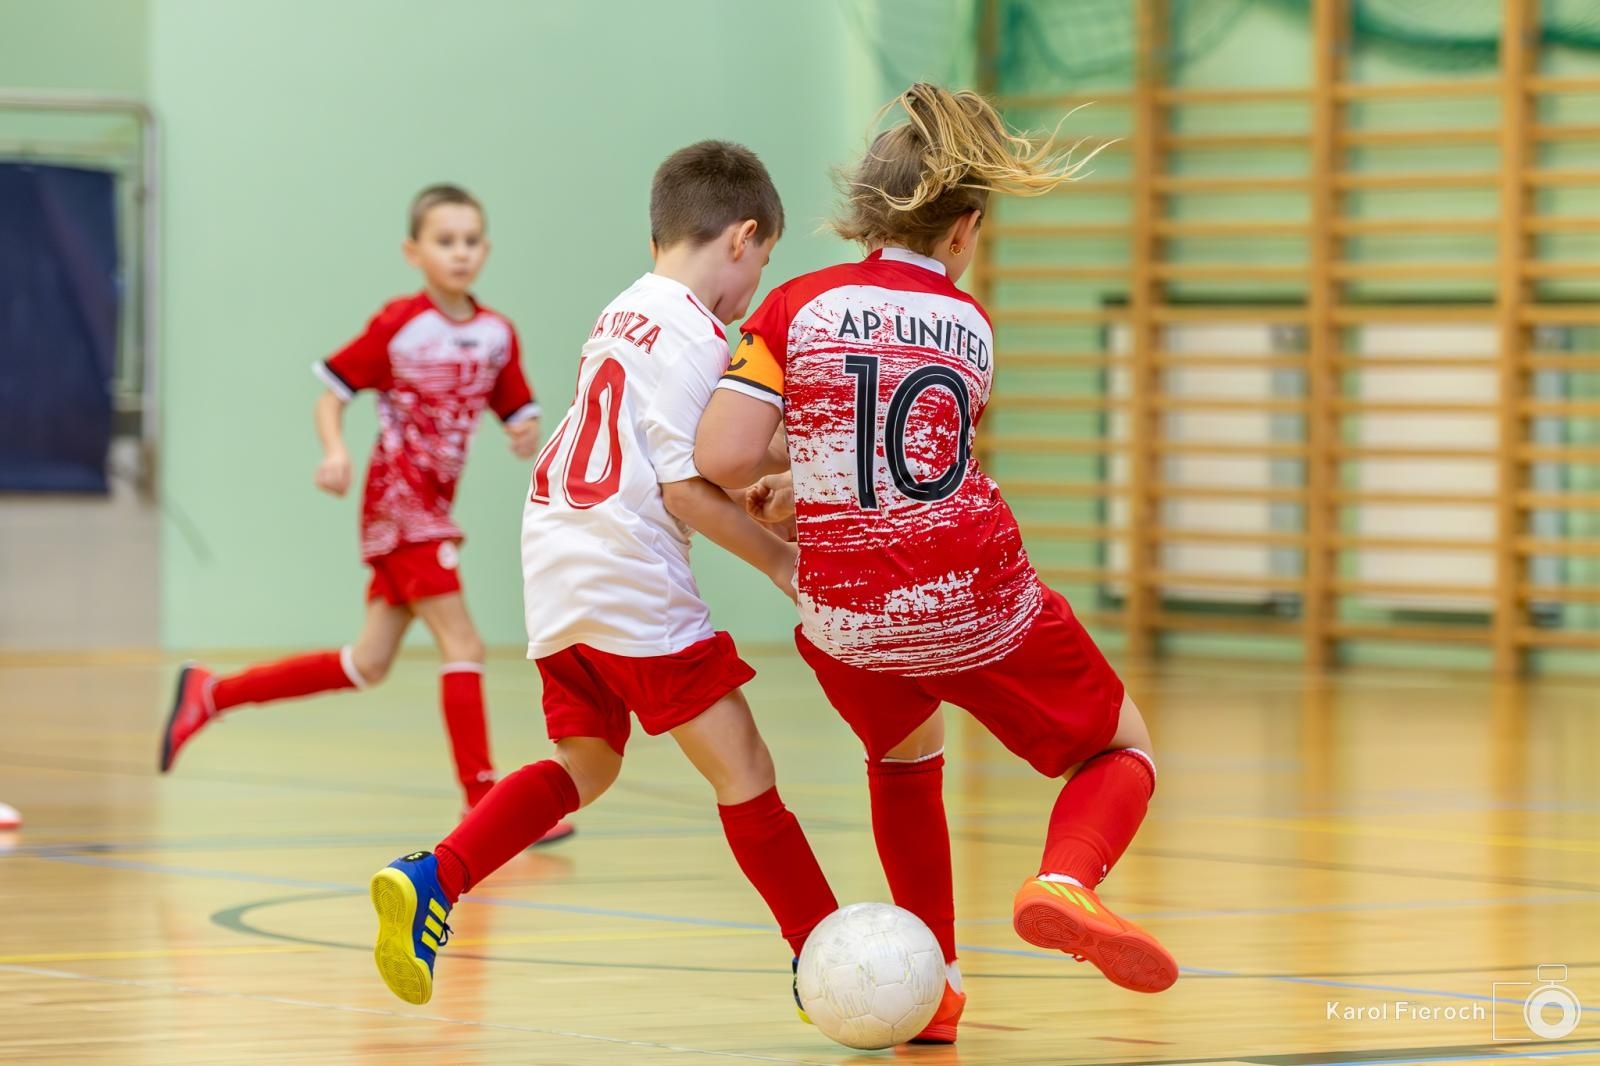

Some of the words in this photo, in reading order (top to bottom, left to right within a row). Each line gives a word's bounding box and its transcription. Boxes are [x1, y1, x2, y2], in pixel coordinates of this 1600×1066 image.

[838, 308, 881, 341] AP
[894, 314, 989, 372] UNITED
[844, 354, 971, 510] 10
